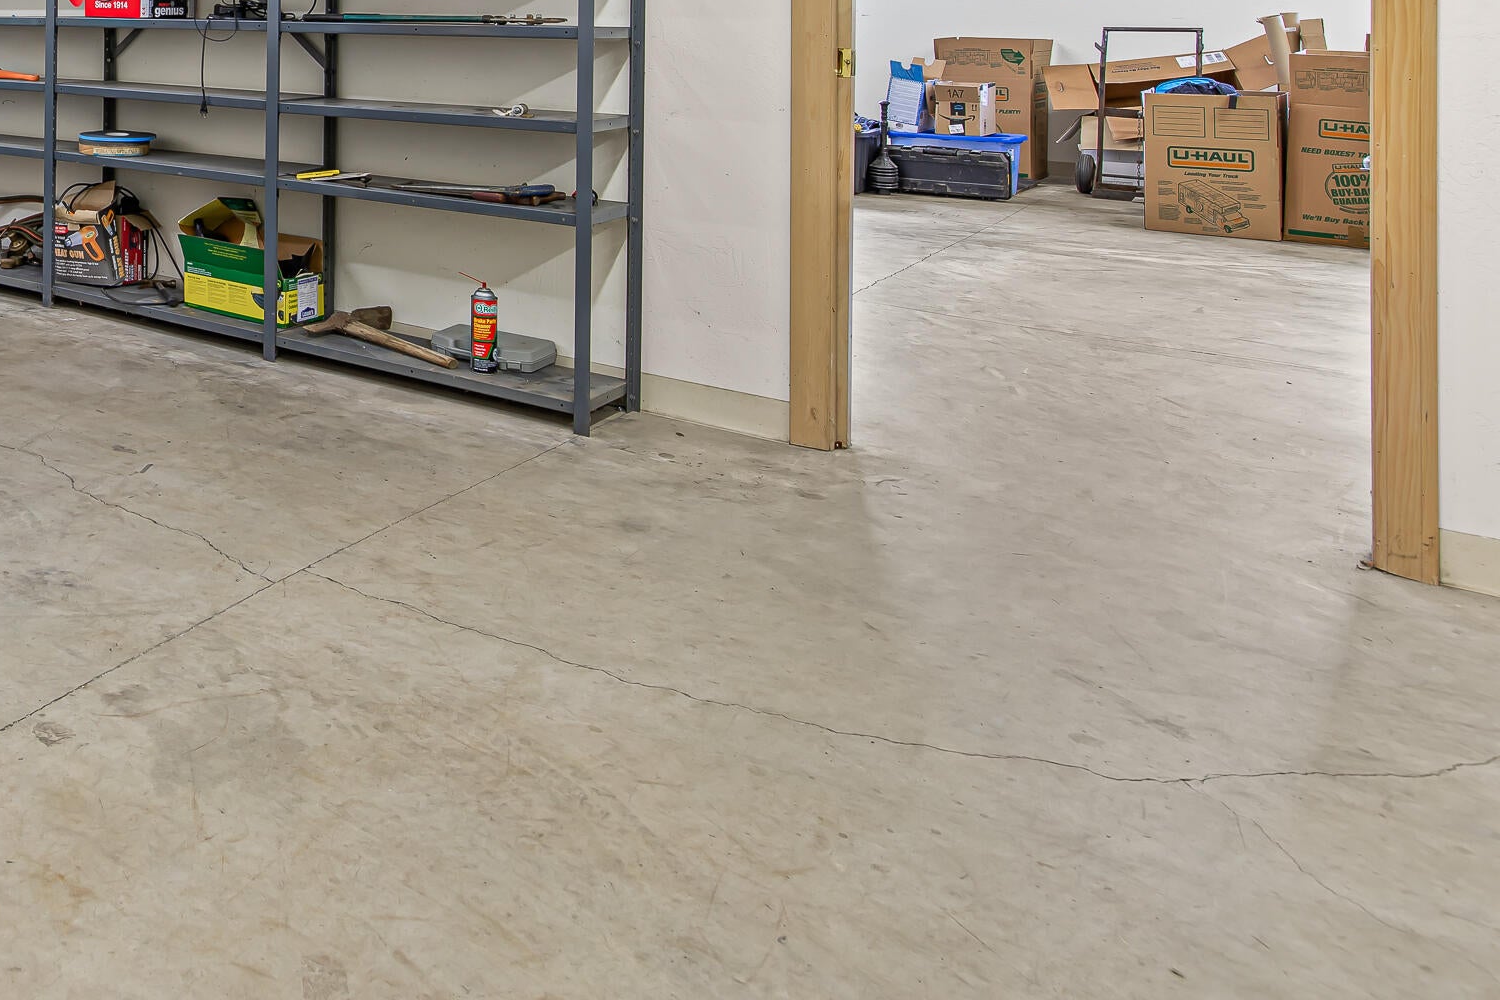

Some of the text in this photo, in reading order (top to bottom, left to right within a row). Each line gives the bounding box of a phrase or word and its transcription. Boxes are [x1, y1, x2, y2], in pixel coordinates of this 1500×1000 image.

[95, 1, 128, 9] Since 1914
[154, 7, 184, 18] genius
[948, 89, 964, 99] 1A7
[1323, 122, 1370, 134] U-HA
[1173, 149, 1249, 163] U-HAUL
[1301, 147, 1322, 155] NEED
[1324, 149, 1356, 158] BOXES?
[1331, 188, 1370, 197] BUY-BA
[1333, 197, 1370, 205] GUARAN
[1302, 214, 1364, 226] We'll Buy Back
[69, 250, 85, 259] GUN
